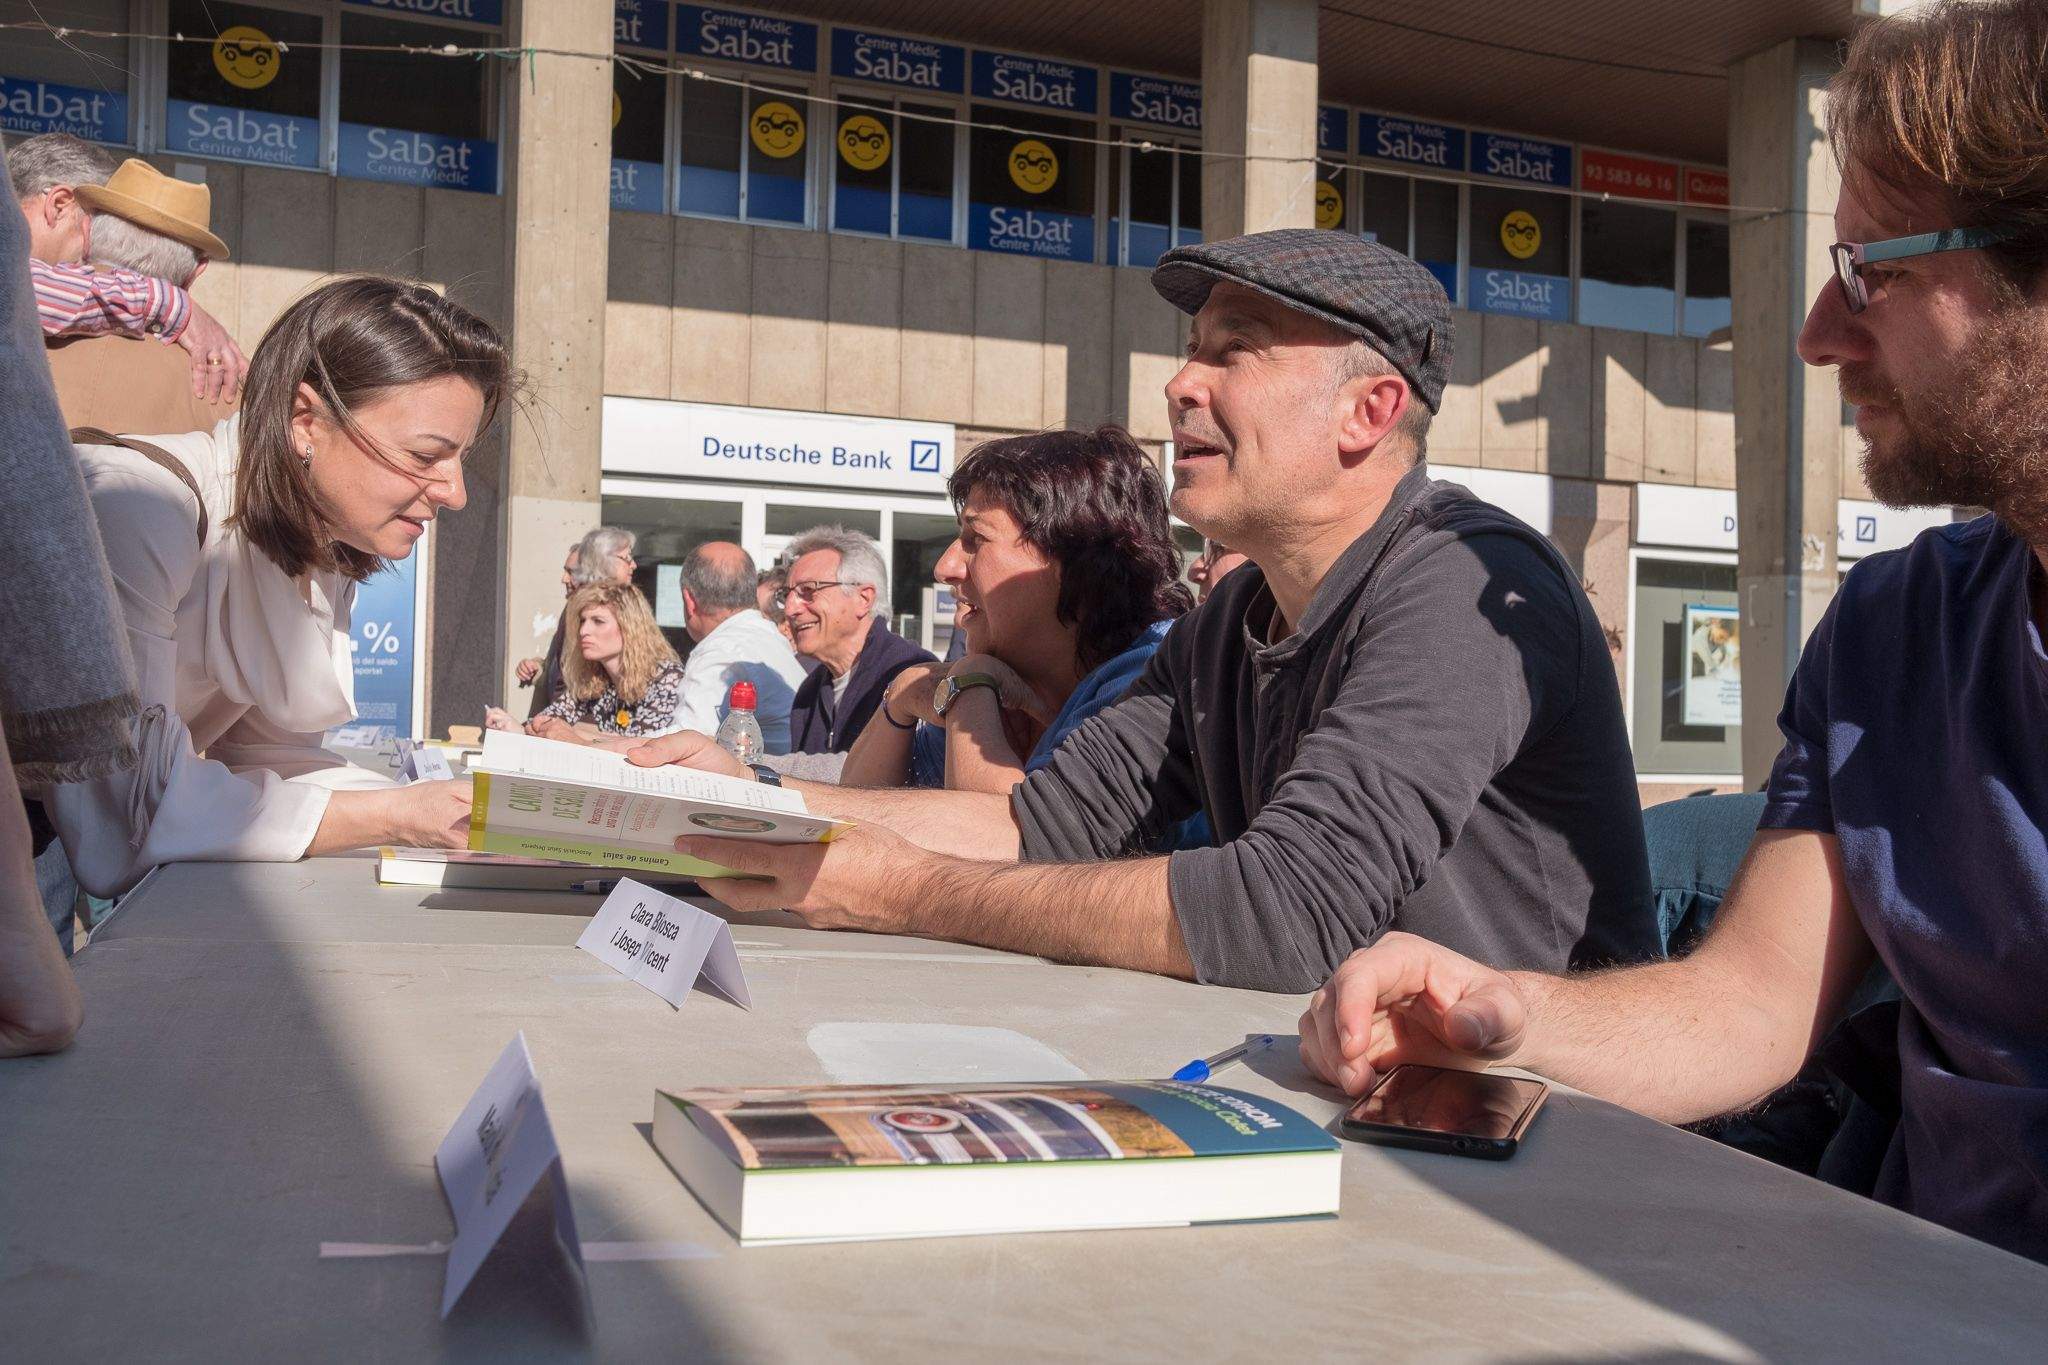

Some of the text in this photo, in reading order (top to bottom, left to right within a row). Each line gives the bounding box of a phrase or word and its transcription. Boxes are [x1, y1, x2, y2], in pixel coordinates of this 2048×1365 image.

[701, 10, 747, 29] Centre
[700, 24, 793, 66] Sabat
[855, 34, 898, 50] Centre
[854, 48, 942, 87] Sabat
[993, 55, 1034, 71] Centre
[992, 69, 1076, 107] Sabat
[1131, 78, 1169, 94] Centre
[0, 114, 42, 132] entre
[1131, 91, 1202, 127] Saba
[187, 104, 300, 149] Sabat
[187, 138, 242, 157] Centre
[367, 128, 472, 171] Sabat
[1377, 130, 1448, 164] Sabat
[367, 160, 417, 179] Centre
[1487, 148, 1554, 181] Sabat
[989, 207, 1074, 243] Sabat
[989, 235, 1030, 252] Centre
[1485, 271, 1553, 303] Sabat
[703, 437, 892, 470] Deutsche Bank
[520, 842, 546, 852] Desperta
[547, 846, 563, 854] Salut
[602, 852, 670, 867] Camins de salut
[630, 902, 653, 927] Clara
[609, 927, 670, 974] i Josep Vicent
